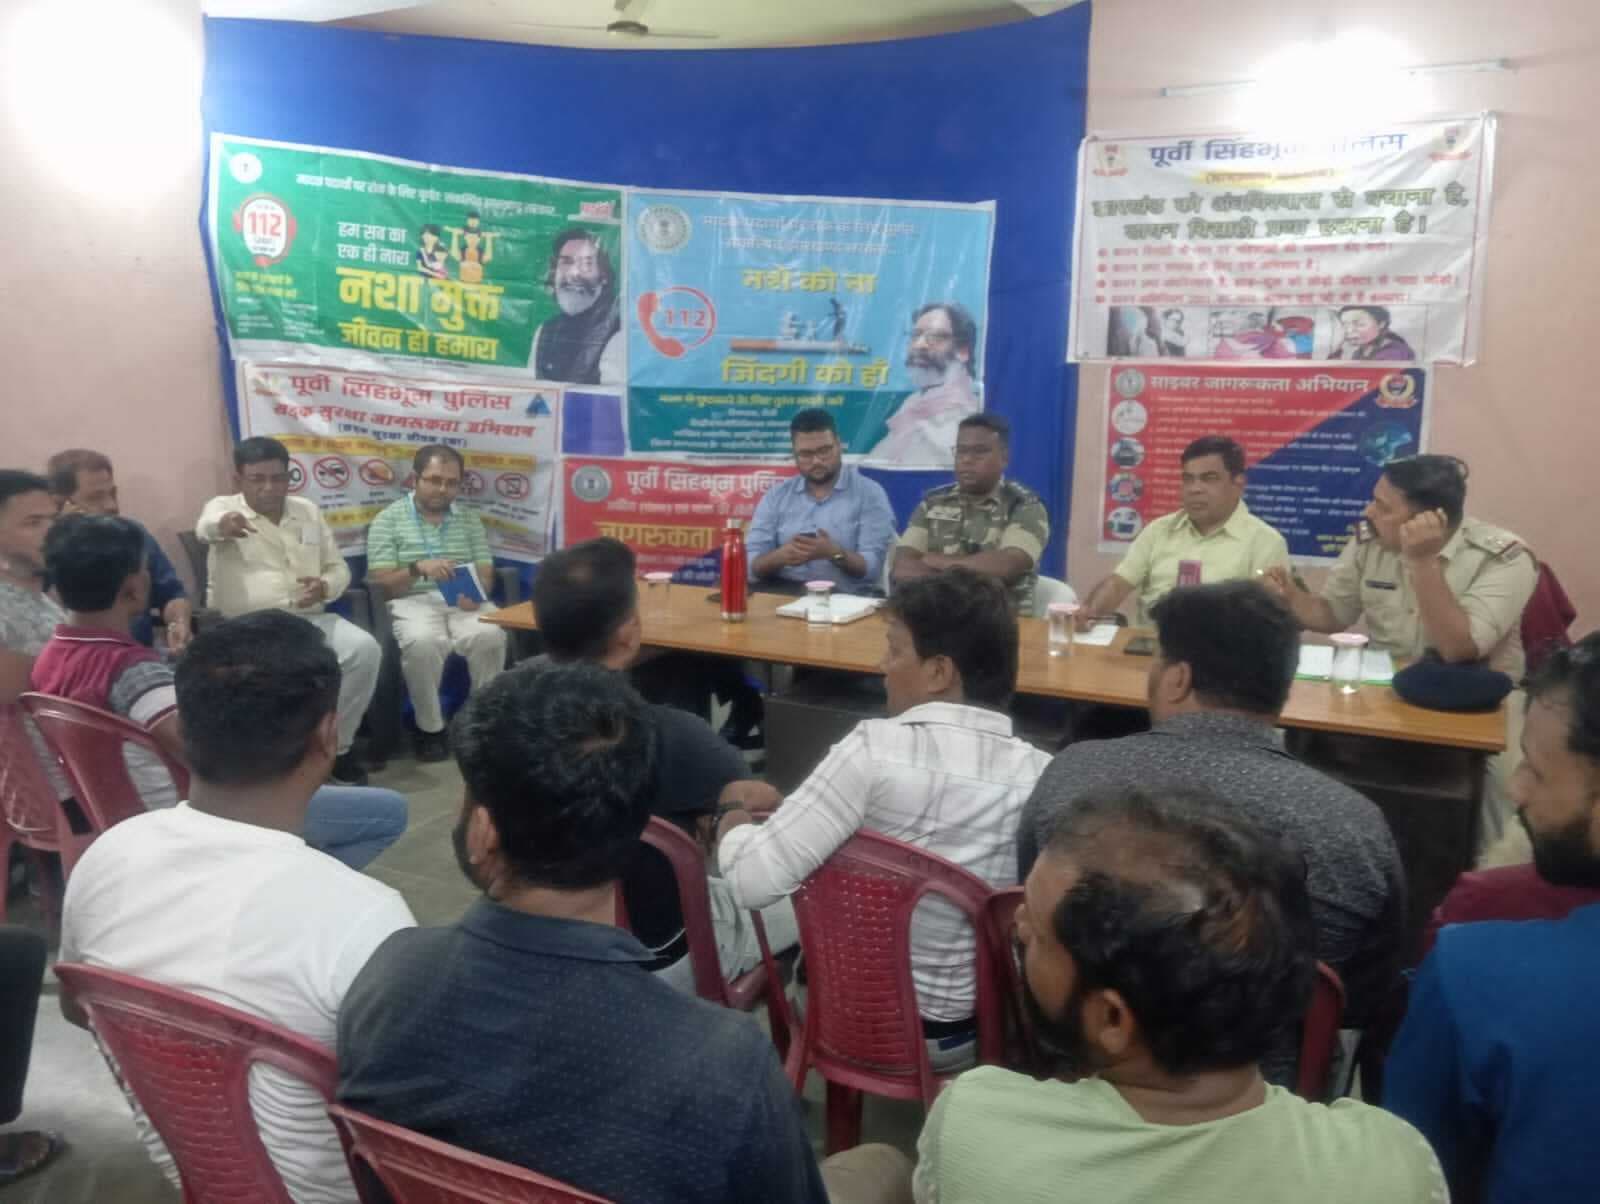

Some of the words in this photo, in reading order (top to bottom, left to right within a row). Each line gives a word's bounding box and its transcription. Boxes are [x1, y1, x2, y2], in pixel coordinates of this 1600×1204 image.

[1149, 139, 1193, 167] पूर्वी
[247, 211, 282, 237] 112
[337, 221, 360, 239] हम
[363, 223, 386, 241] सब
[387, 227, 407, 243] का
[336, 243, 359, 260] एक
[363, 243, 377, 263] ही
[379, 248, 410, 266] नारा
[799, 266, 838, 293] को
[845, 272, 877, 294] ना
[336, 266, 422, 313] नशा
[430, 279, 505, 331] मुक्त
[665, 309, 706, 327] 112
[337, 316, 402, 350] जीवन
[434, 332, 499, 361] हमारा
[722, 355, 808, 385] जिंदगी
[815, 358, 852, 386] को
[1294, 373, 1370, 394] अभियान
[342, 376, 433, 406] सिंहभूम
[443, 386, 512, 412] पुलिस
[317, 404, 366, 425] सुरक्षा
[465, 419, 536, 439] अभियान
[626, 466, 660, 494] पूर्वी
[664, 467, 735, 496] सिंहभूम
